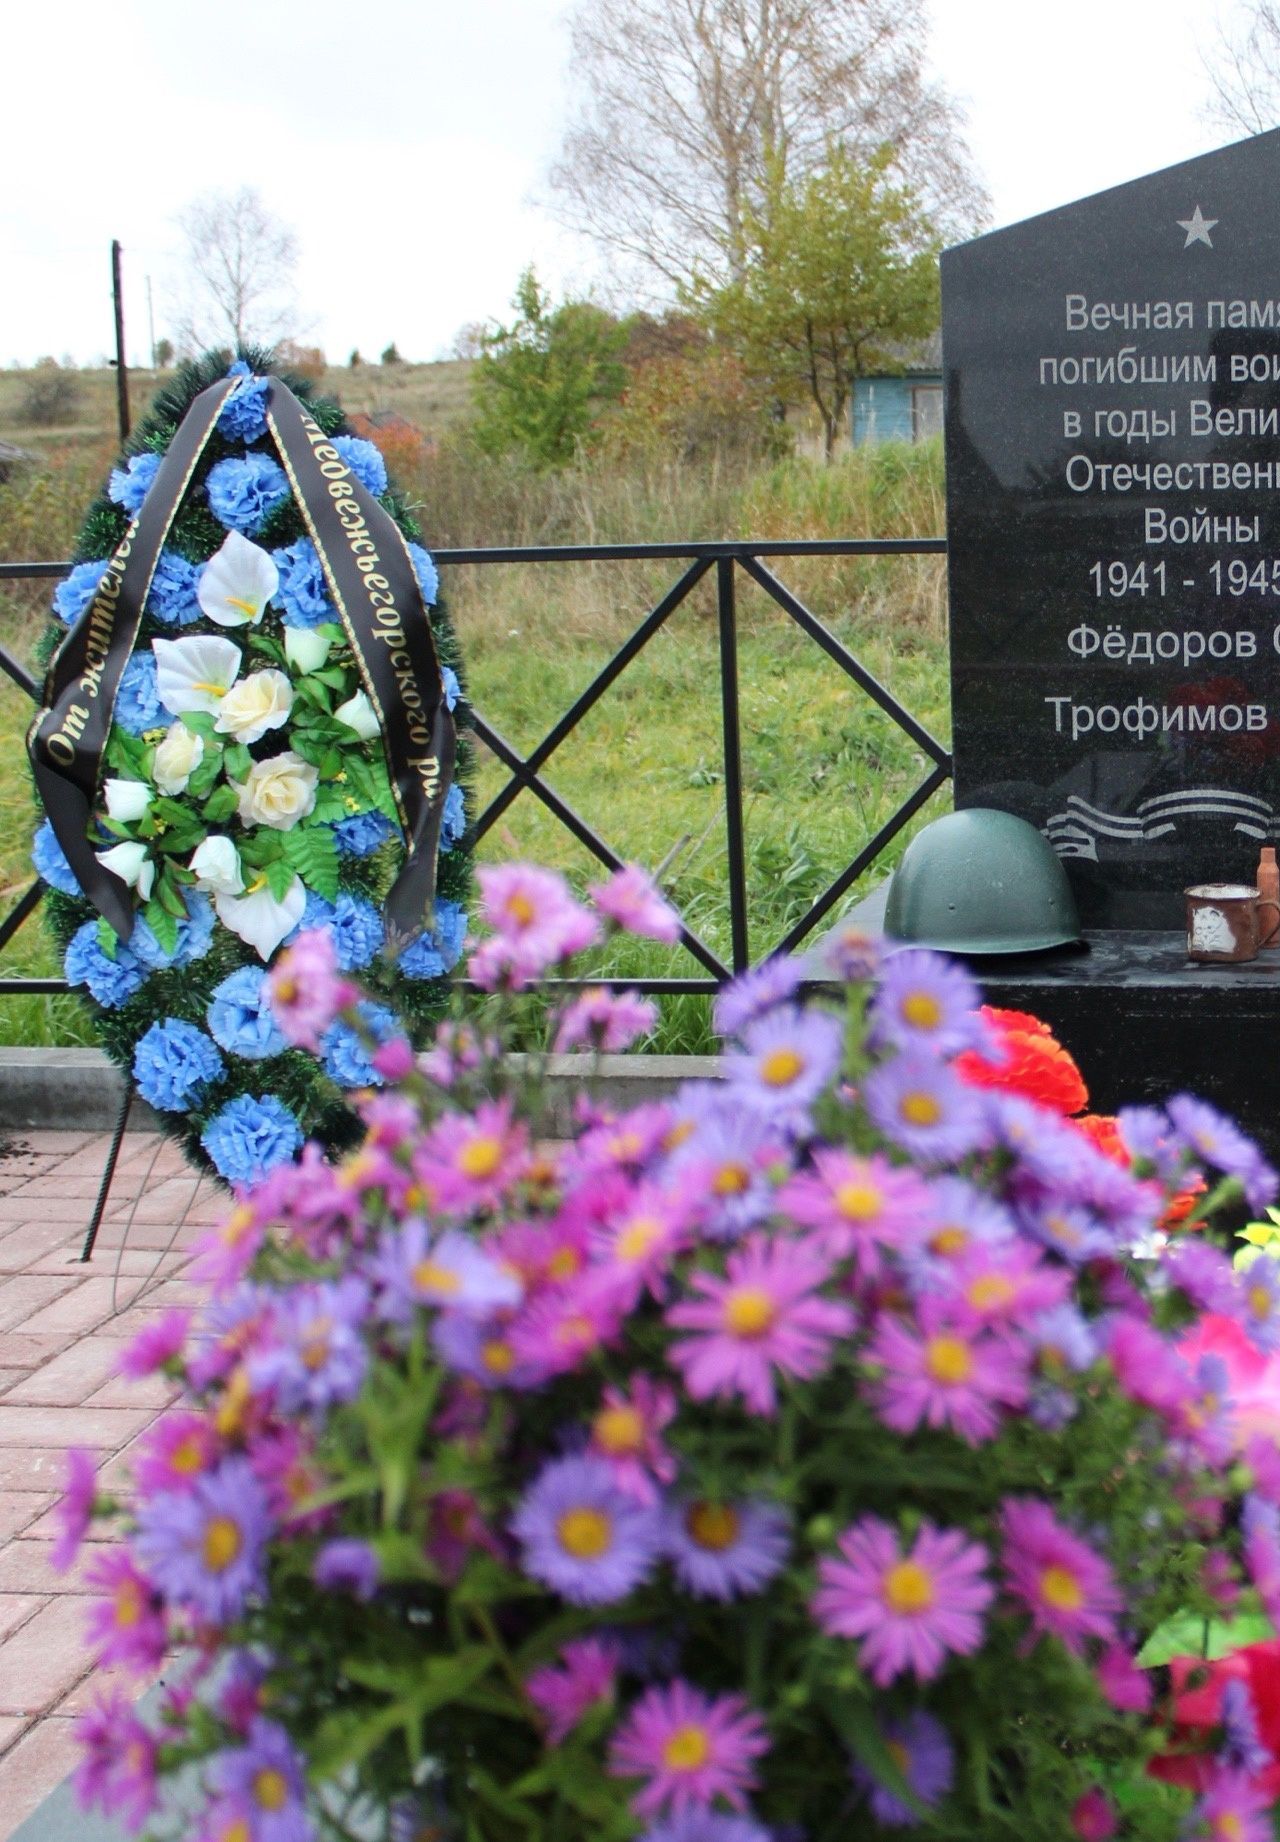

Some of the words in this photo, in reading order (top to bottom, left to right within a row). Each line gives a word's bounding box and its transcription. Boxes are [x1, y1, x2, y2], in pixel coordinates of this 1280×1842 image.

[1066, 294, 1193, 331] Вечная
[1040, 346, 1216, 385] погибшим
[1063, 411, 1082, 438] в
[1095, 410, 1176, 444] годы
[1145, 507, 1259, 544] Войны
[1089, 561, 1166, 597] 1941
[1067, 623, 1257, 667] Фёдоров
[46, 703, 91, 768] От
[1044, 697, 1268, 741] Трофимов
